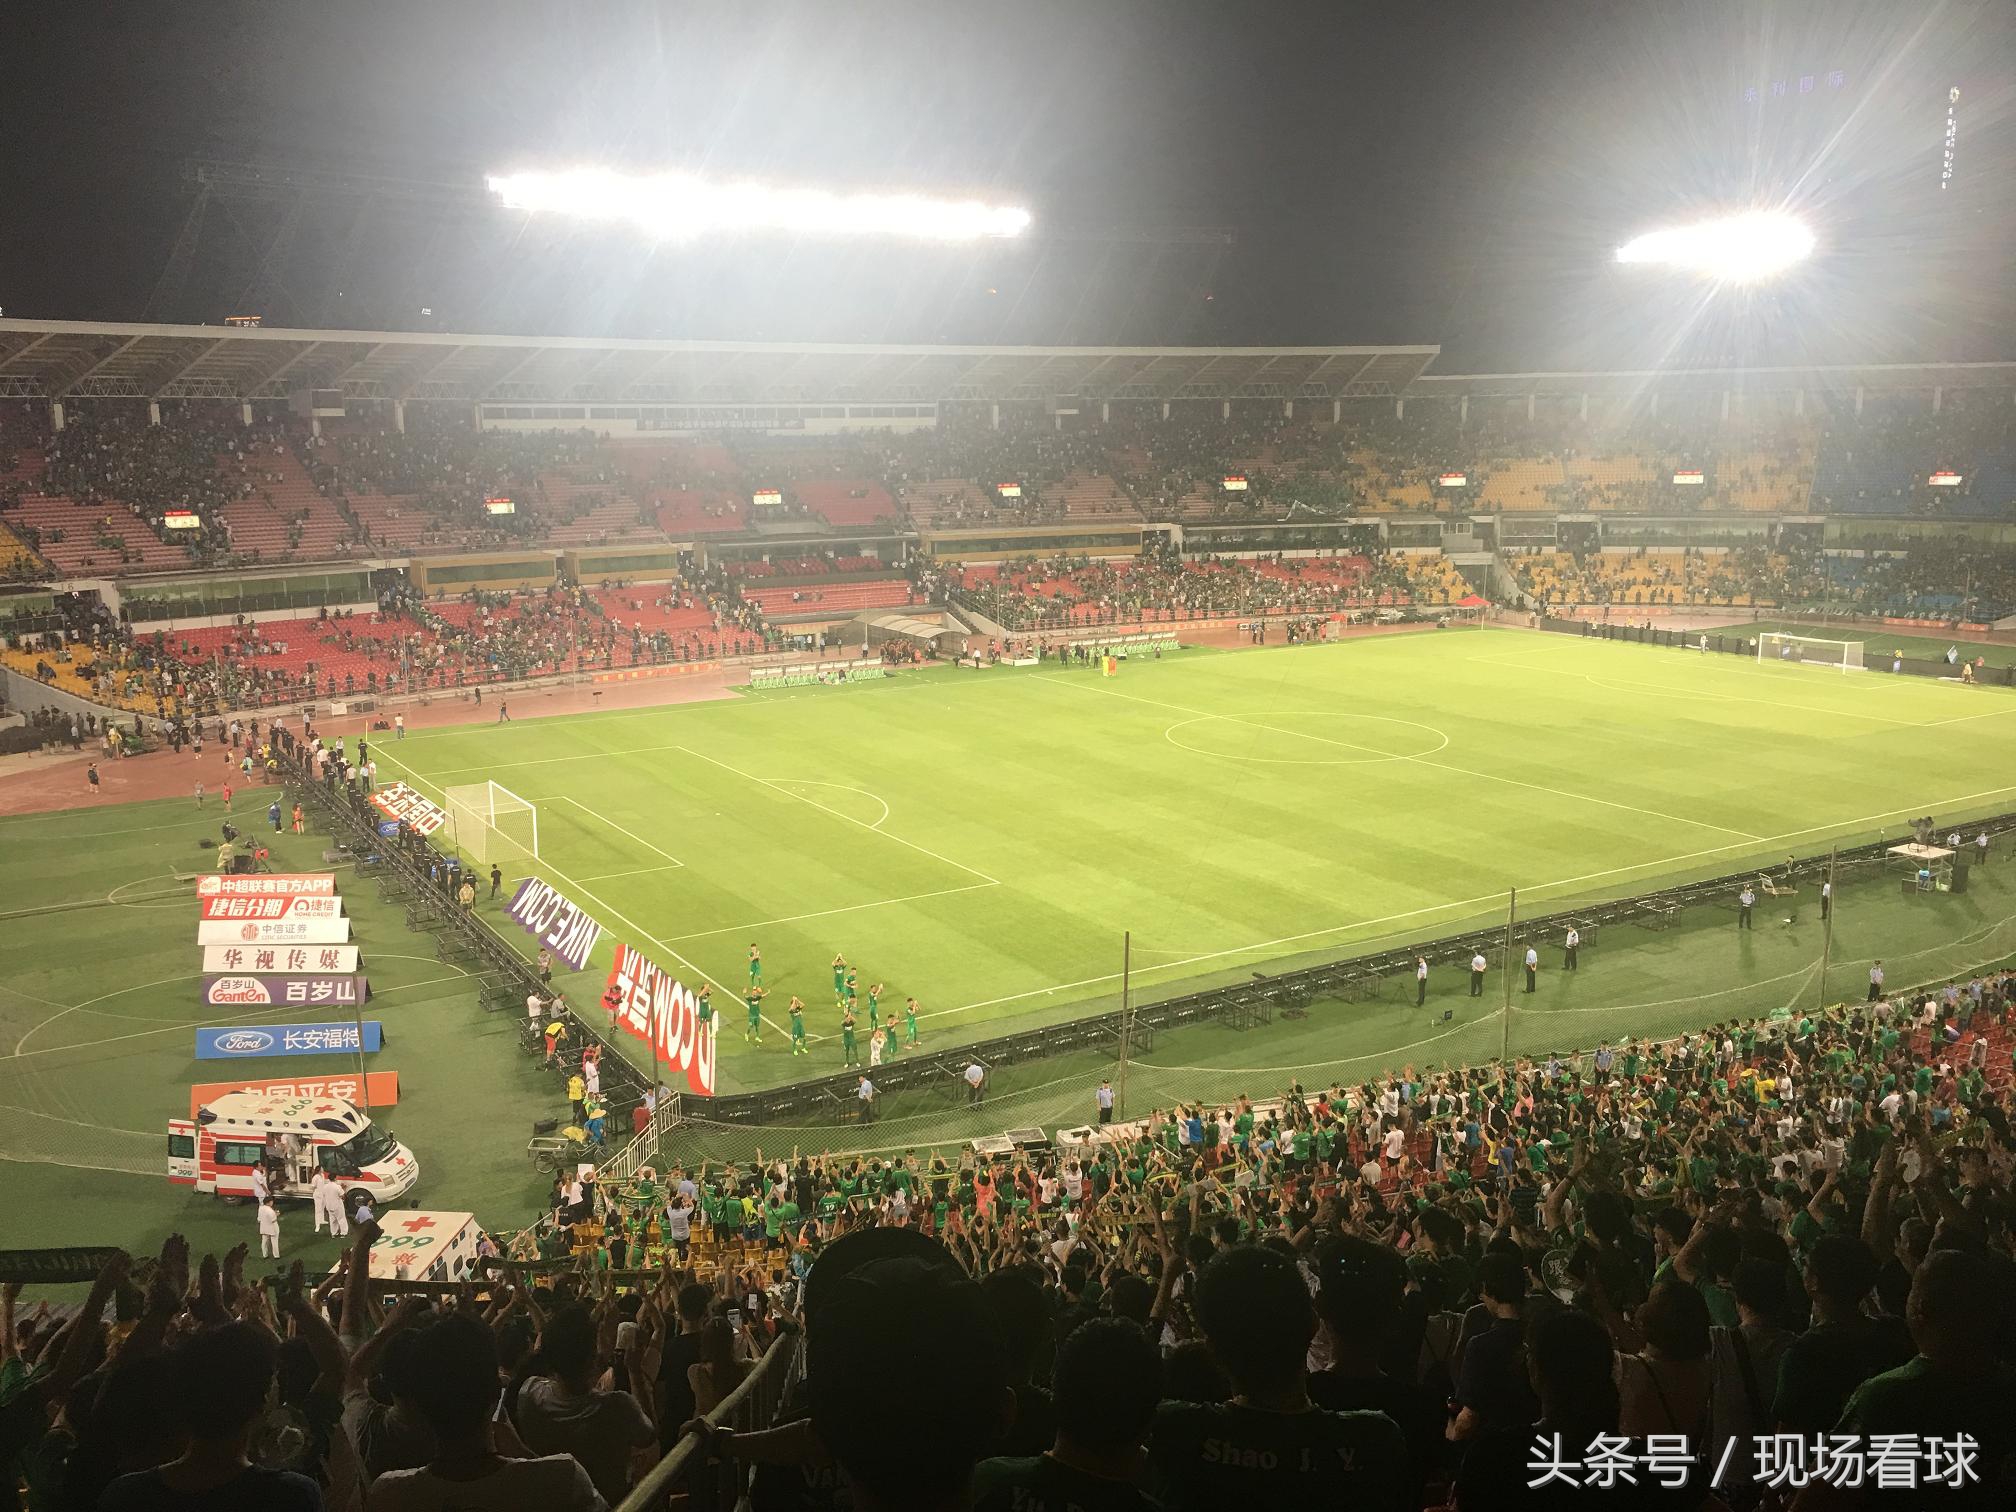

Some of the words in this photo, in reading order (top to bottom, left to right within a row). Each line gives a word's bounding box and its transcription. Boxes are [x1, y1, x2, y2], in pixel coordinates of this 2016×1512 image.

[222, 879, 333, 893] 中超联赛官方APP
[208, 898, 284, 917] 捷信分期
[311, 900, 334, 911] 捷信
[262, 923, 308, 934] 中信证券
[511, 877, 602, 970] NIKE.COM
[223, 948, 341, 970] 华视传媒
[220, 979, 255, 989] 百岁山
[286, 981, 356, 1001] 百岁山
[226, 1035, 261, 1049] Ford
[283, 1028, 360, 1050] 长安福特
[1200, 1438, 1280, 1470] Shao
